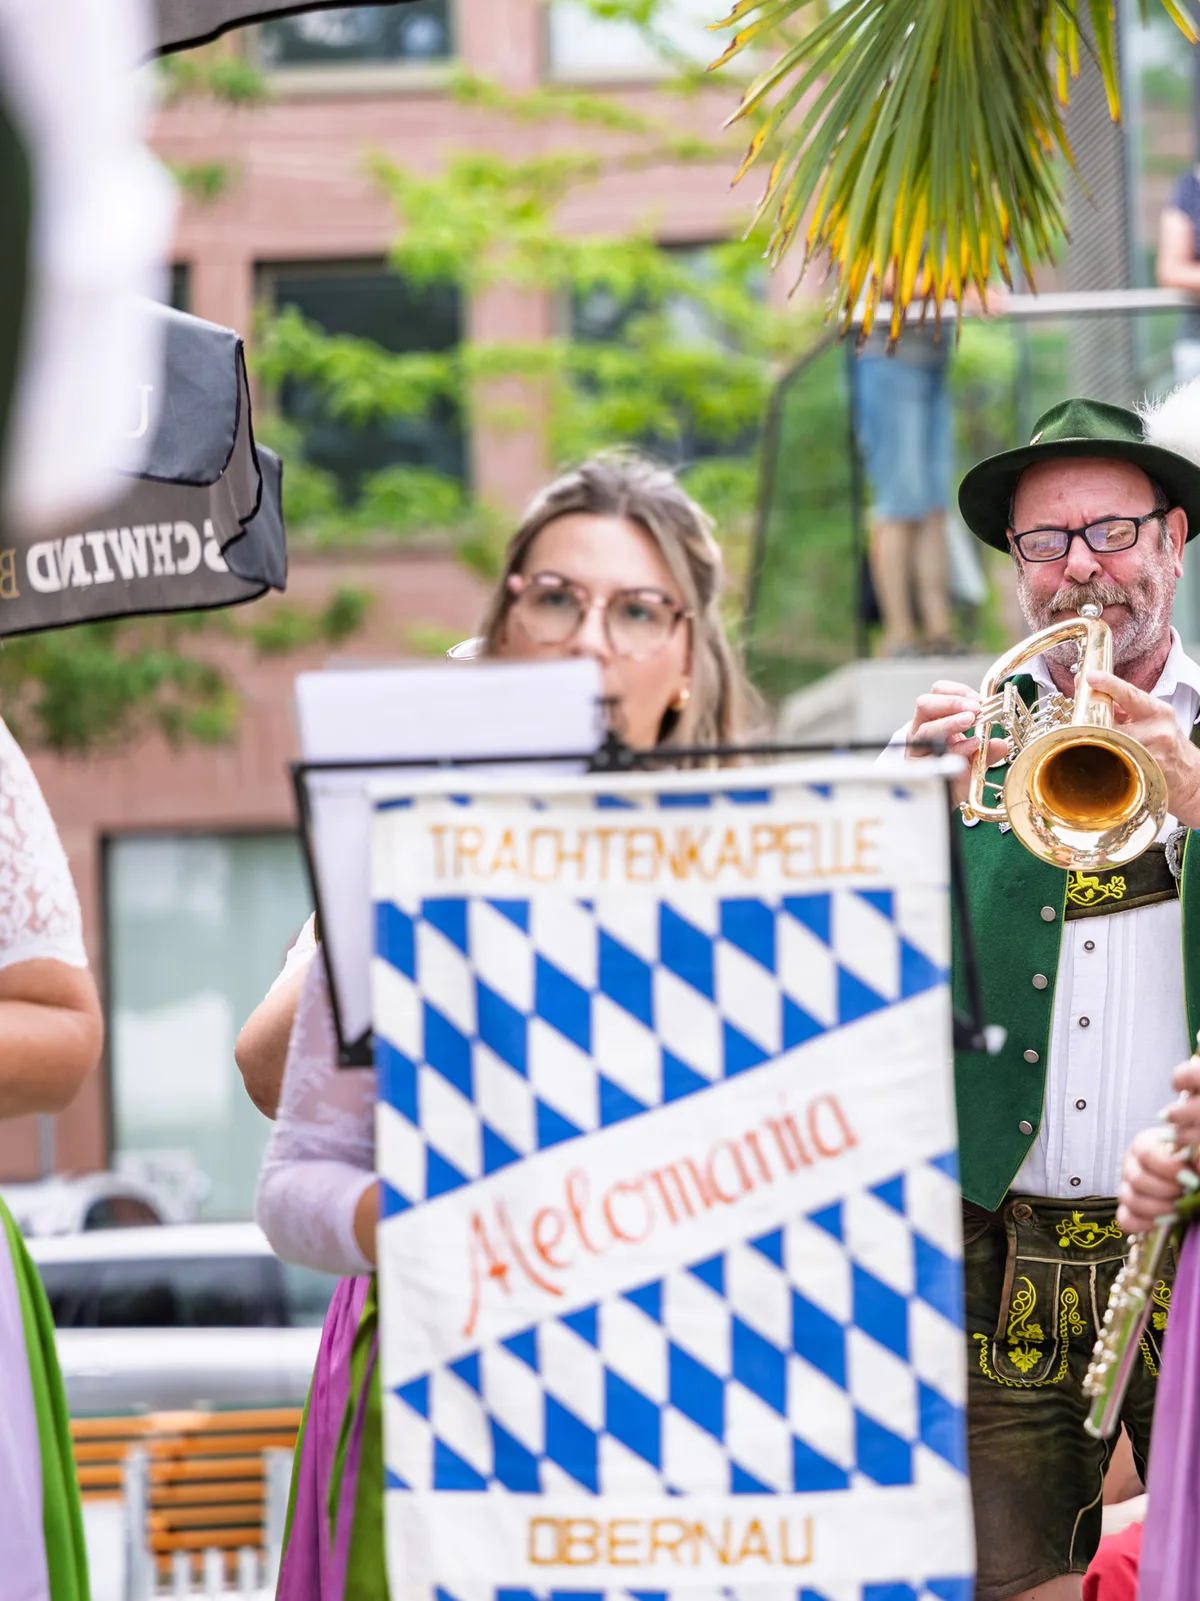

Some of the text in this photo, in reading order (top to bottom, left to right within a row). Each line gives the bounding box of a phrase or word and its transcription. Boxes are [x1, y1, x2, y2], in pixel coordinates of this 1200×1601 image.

[426, 818, 884, 882] TRACHTENKAPELLE
[462, 1092, 859, 1338] Melomania
[528, 1515, 814, 1566] OBERNAU
